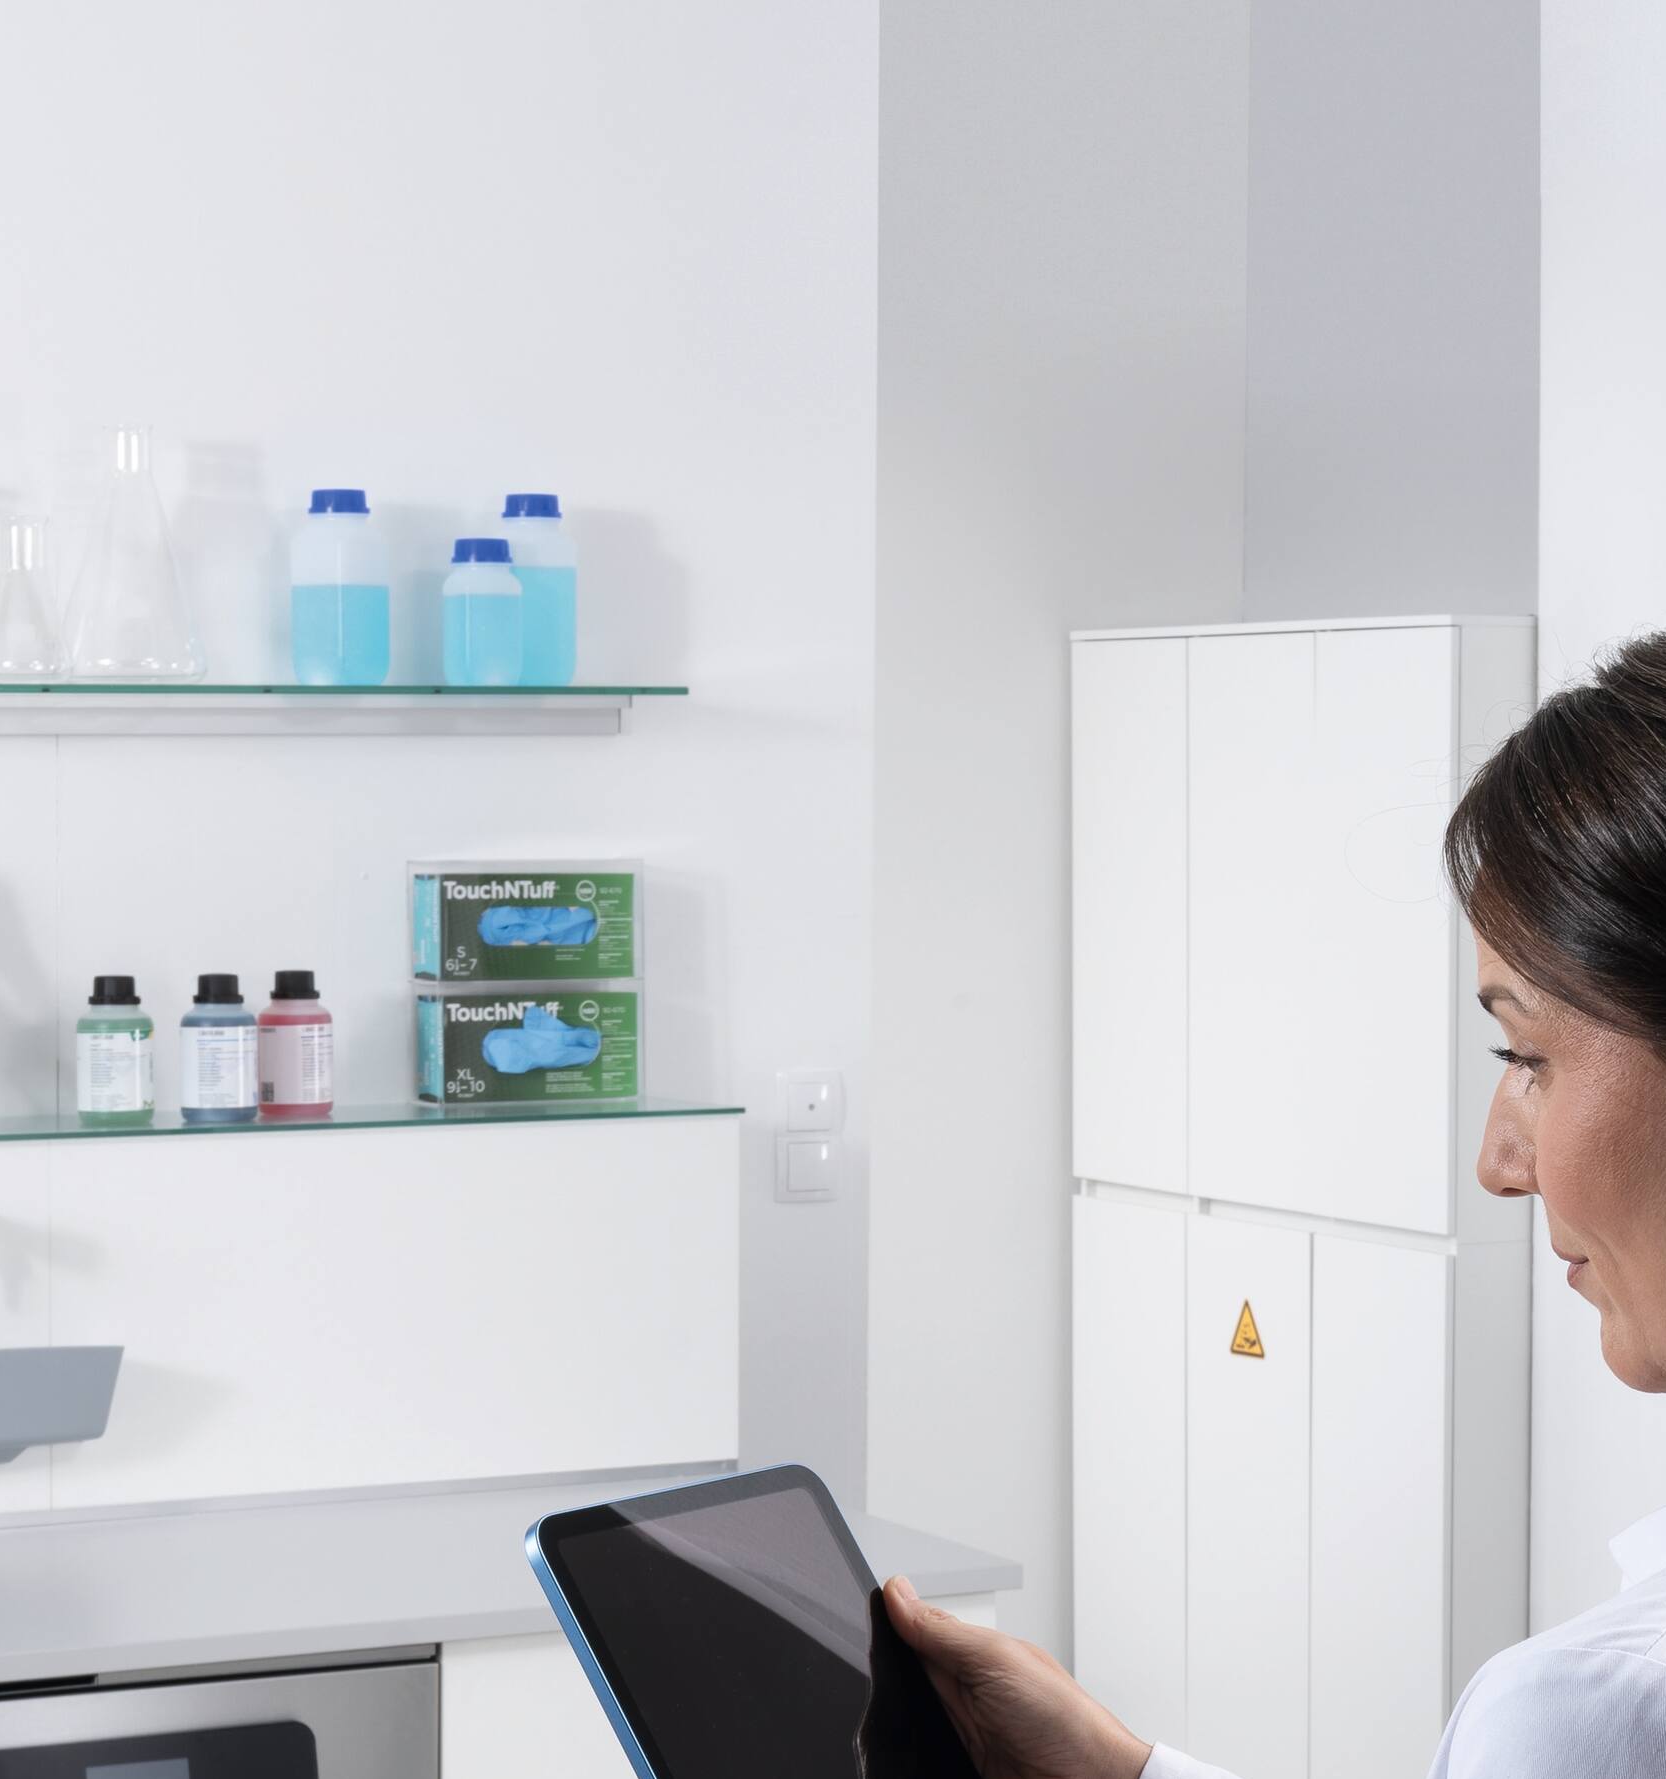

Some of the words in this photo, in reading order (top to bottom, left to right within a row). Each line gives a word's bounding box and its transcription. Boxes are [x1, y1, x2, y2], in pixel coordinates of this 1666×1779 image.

[442, 880, 557, 900] TouchNTuff
[456, 945, 466, 959] S
[446, 1000, 559, 1022] TouchNff
[456, 1068, 475, 1080] XL
